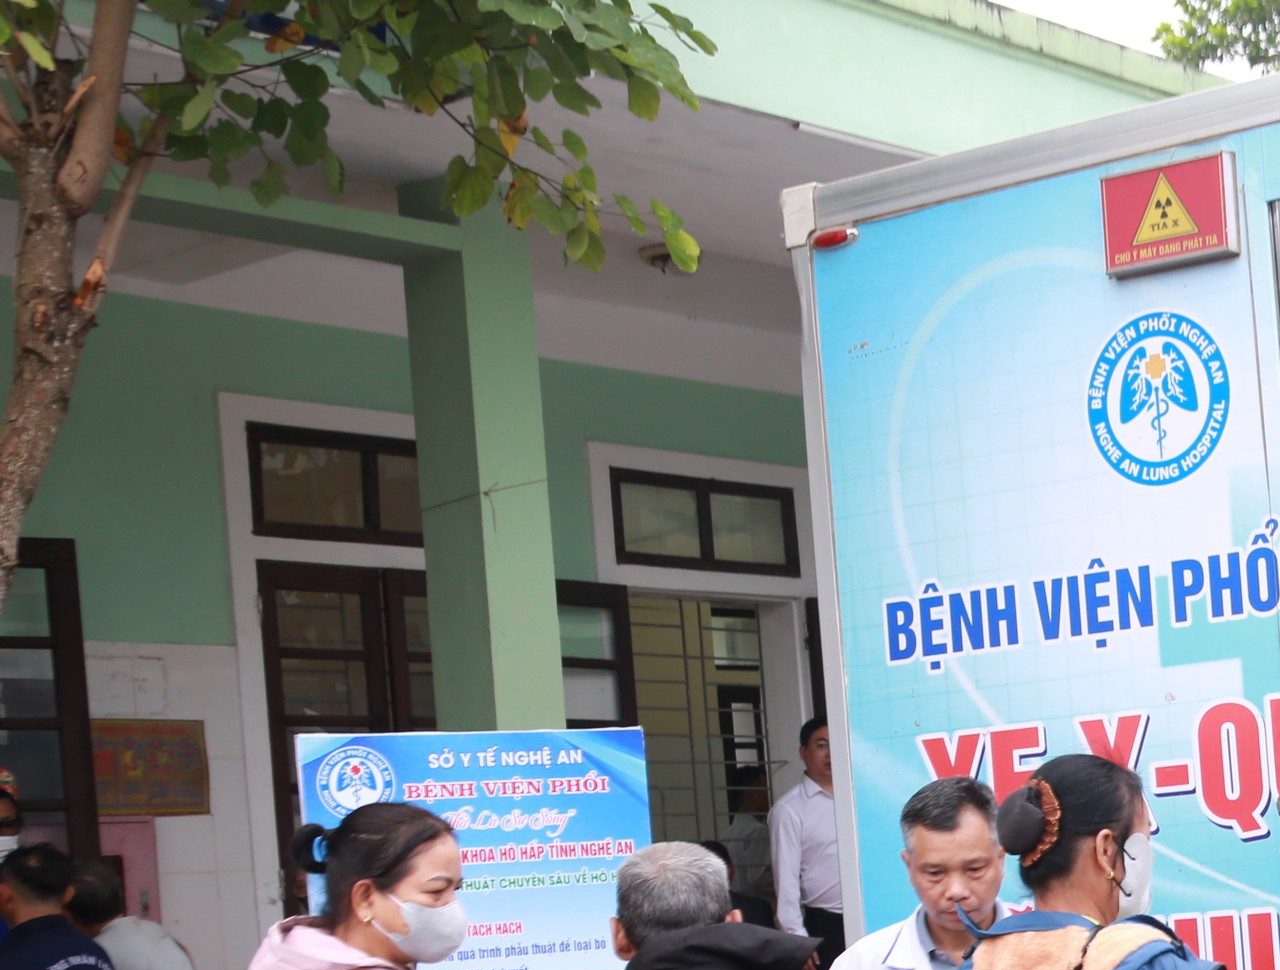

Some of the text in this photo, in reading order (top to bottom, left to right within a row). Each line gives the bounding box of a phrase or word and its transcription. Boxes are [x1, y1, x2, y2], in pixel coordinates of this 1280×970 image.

[1150, 218, 1180, 232] TIA X
[1204, 234, 1218, 246] TIA
[1089, 312, 1225, 410] BỆNH VIỆN PHỔI NGHỆ AN
[1094, 400, 1225, 482] NGHE AN LUNG HOSPITAL
[886, 582, 1020, 671] BỆNH
[1033, 557, 1155, 649] VIỆN
[428, 745, 583, 769] SỞ Y TẾ NGHỆ AN
[404, 778, 476, 803] BỆNH
[483, 776, 543, 800] VIỆN
[549, 770, 609, 793] PHỔI
[462, 848, 496, 864] KHOA
[520, 843, 544, 862] HẤP
[548, 840, 577, 859] TỈNH
[580, 841, 612, 860] NGHỆ
[616, 841, 633, 855] AN
